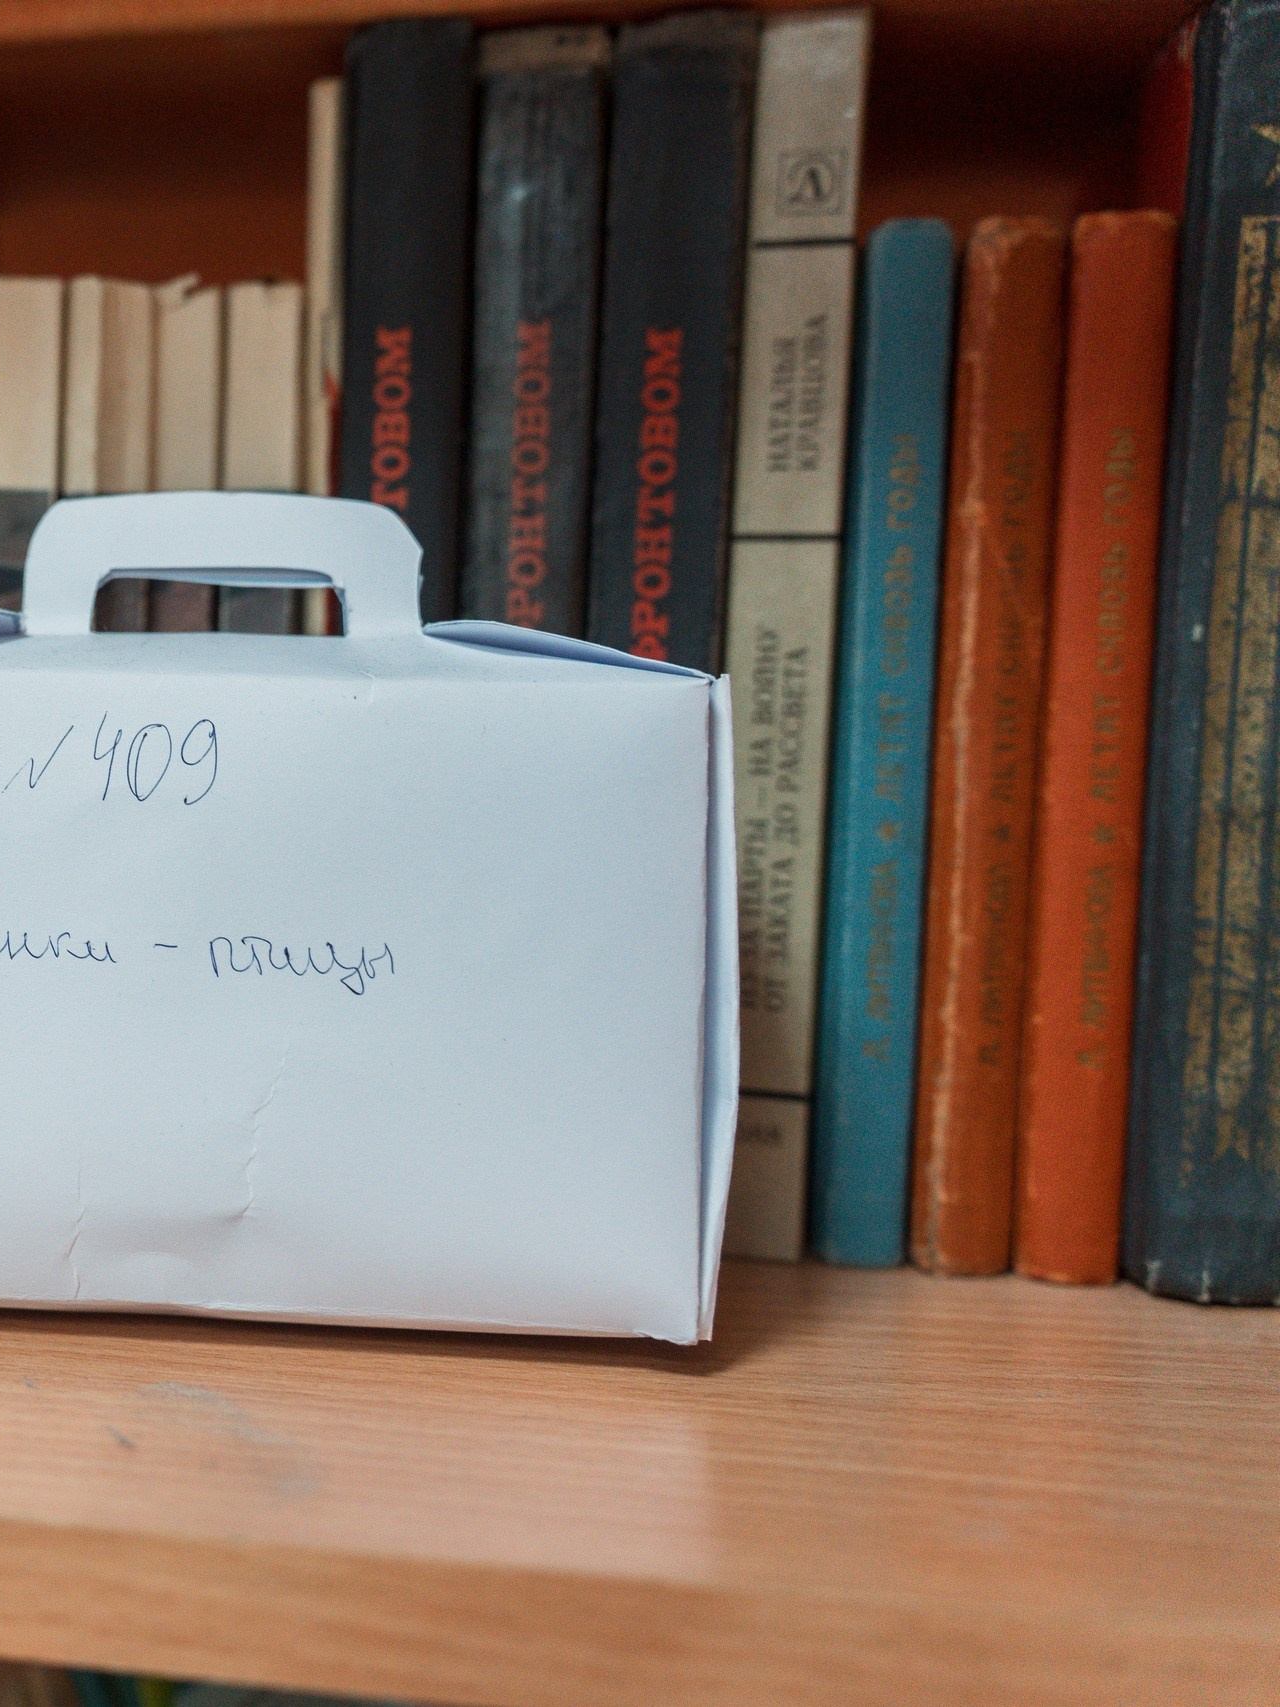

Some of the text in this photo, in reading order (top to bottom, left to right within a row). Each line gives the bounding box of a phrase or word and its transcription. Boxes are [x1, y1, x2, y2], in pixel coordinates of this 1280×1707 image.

[370, 326, 412, 514] ТОВОМ
[506, 317, 553, 628] РОНТОВОМ
[884, 433, 923, 533] ГОДЫ
[1100, 424, 1141, 528] ГОДЫ
[1093, 542, 1131, 679] СКВОЗЬ
[751, 624, 780, 726] ВОЙНУ
[774, 645, 808, 794] РАССВЕТА
[92, 710, 219, 806] 409
[747, 736, 773, 778] НА
[1089, 691, 1122, 806] ЛЕТЯТ
[773, 801, 801, 847] ДО
[209, 935, 395, 996] птицы
